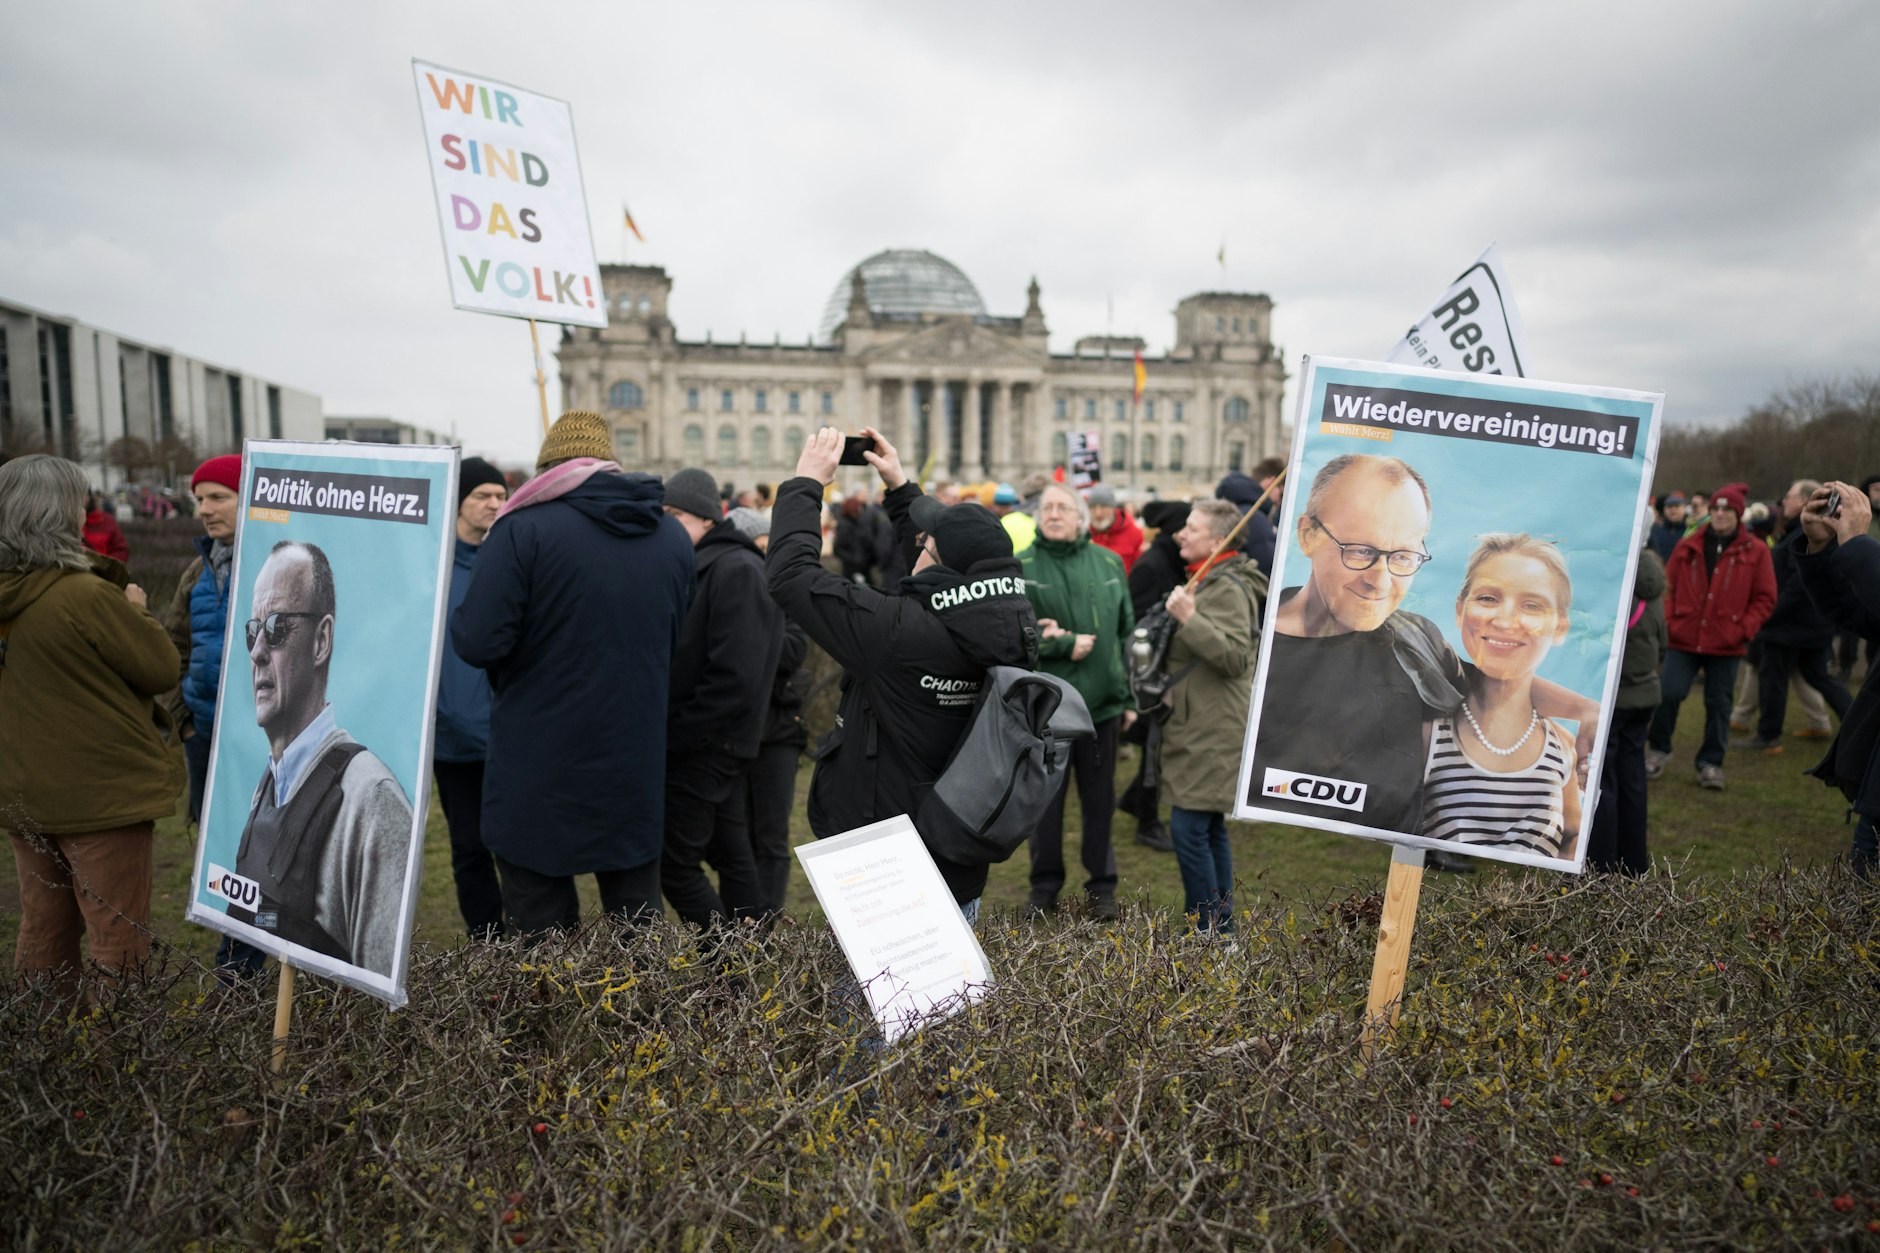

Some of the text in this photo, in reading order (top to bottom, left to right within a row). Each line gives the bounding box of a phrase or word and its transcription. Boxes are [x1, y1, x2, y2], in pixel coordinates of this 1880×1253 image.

[425, 72, 523, 128] WIR
[441, 133, 549, 187] SIND
[451, 194, 542, 243] DAS
[458, 254, 595, 309] VOLK!
[1432, 286, 1502, 375] Res
[1333, 394, 1627, 455] Wiedervereinigung!
[255, 476, 424, 517] Politik ohne Herz.
[931, 577, 1014, 610] CHAOTIC
[1290, 778, 1362, 805] CDU
[221, 874, 257, 905] CDU
